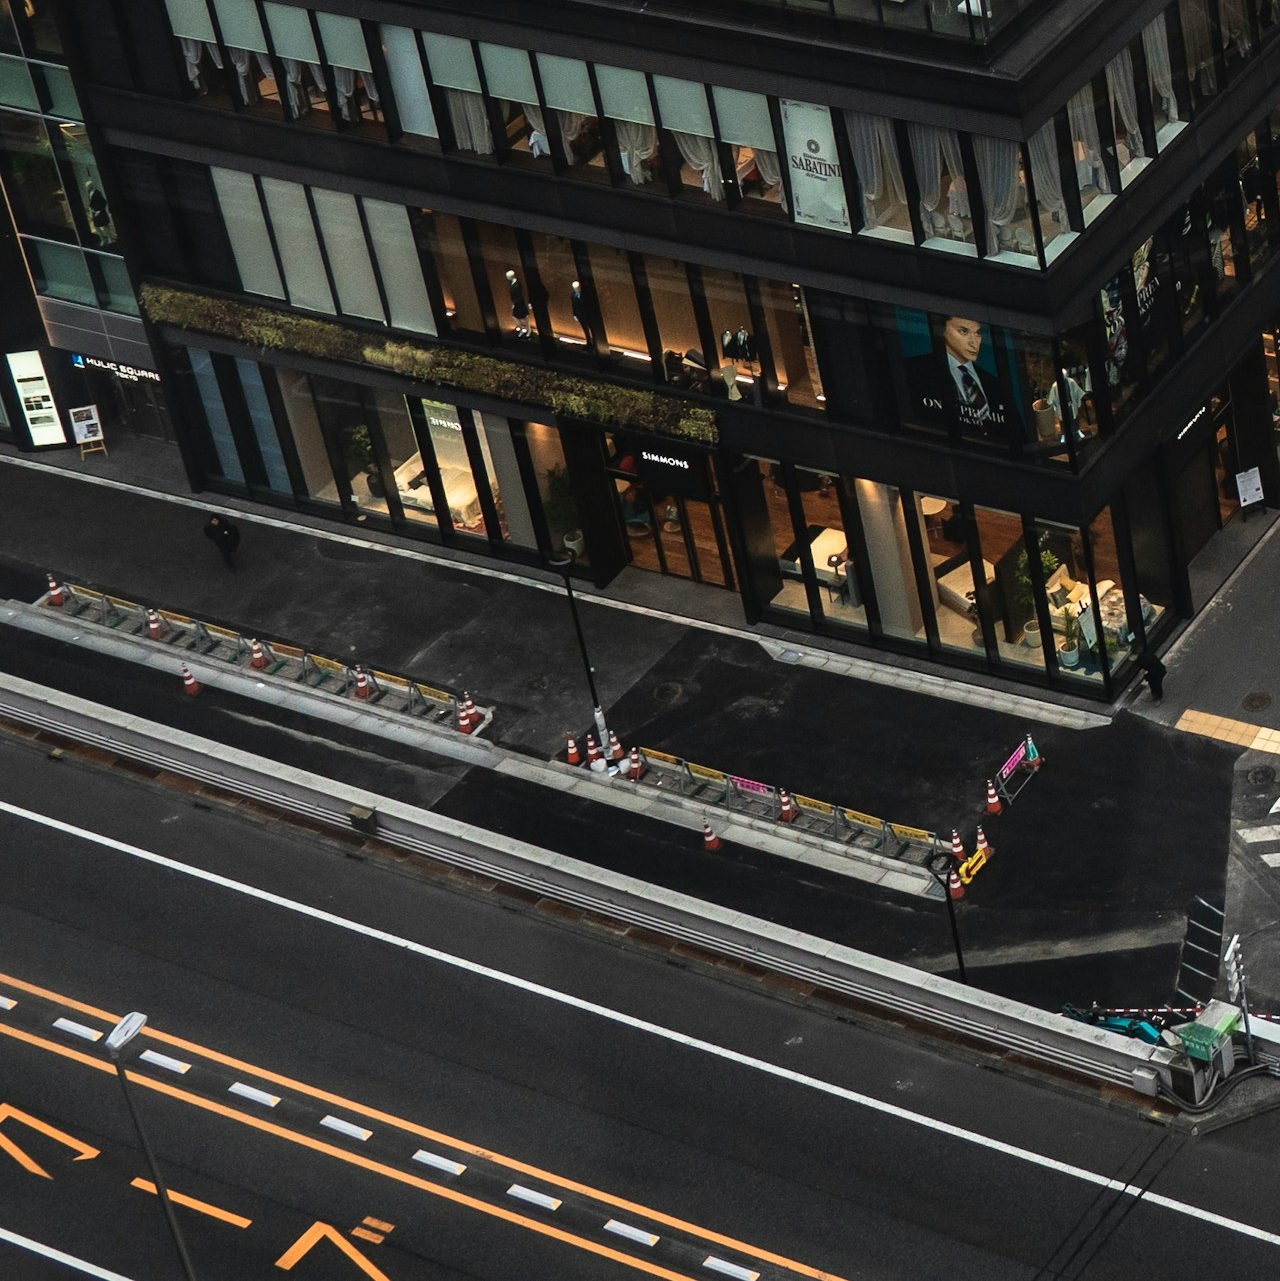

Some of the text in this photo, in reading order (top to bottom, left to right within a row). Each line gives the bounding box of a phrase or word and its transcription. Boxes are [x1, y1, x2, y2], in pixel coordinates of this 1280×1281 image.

[791, 154, 843, 178] SABATINI
[85, 357, 161, 382] HULIC SQUARE
[641, 451, 690, 469] SIMMONS
